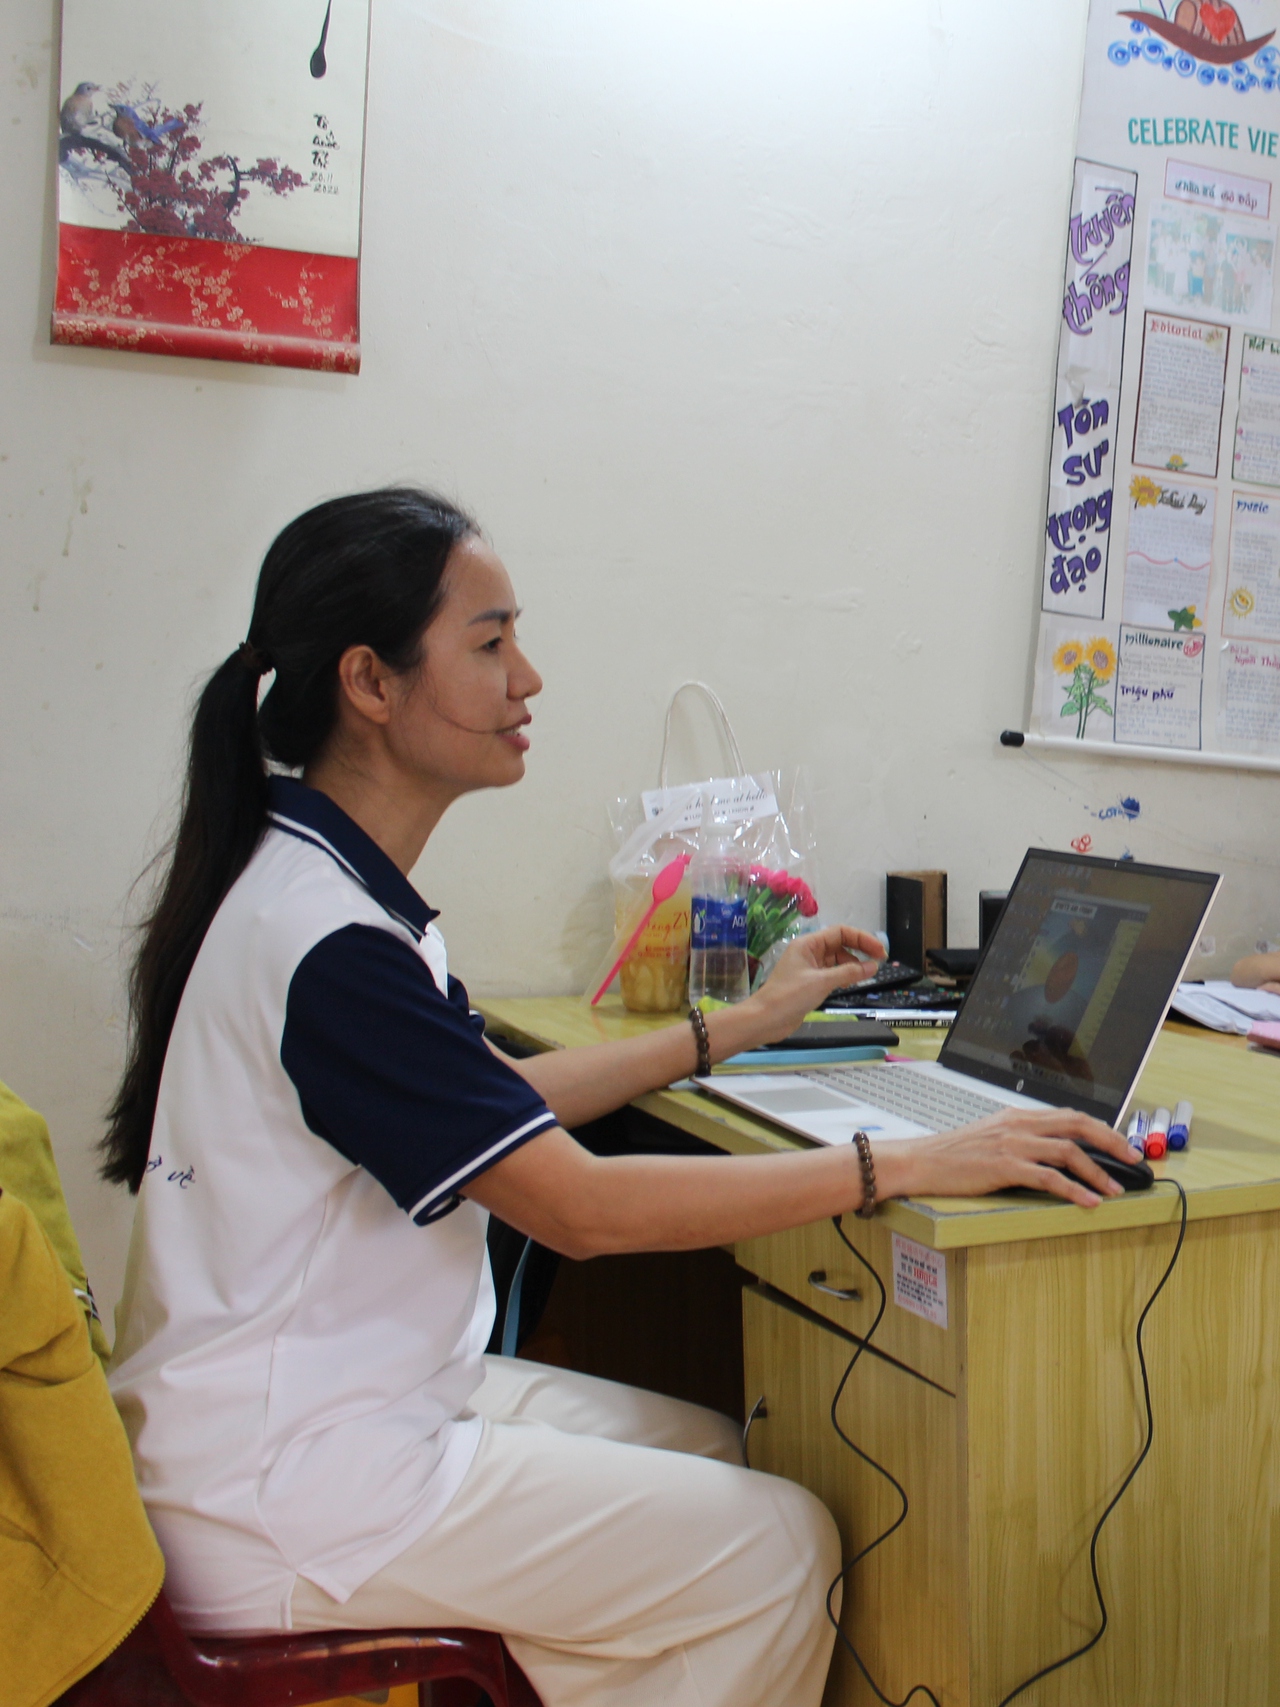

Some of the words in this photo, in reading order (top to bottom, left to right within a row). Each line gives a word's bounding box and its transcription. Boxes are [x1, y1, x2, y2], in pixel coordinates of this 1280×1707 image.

[1128, 117, 1239, 150] CELEBRATE
[1150, 319, 1203, 341] Editorial
[1050, 547, 1101, 595] đạo
